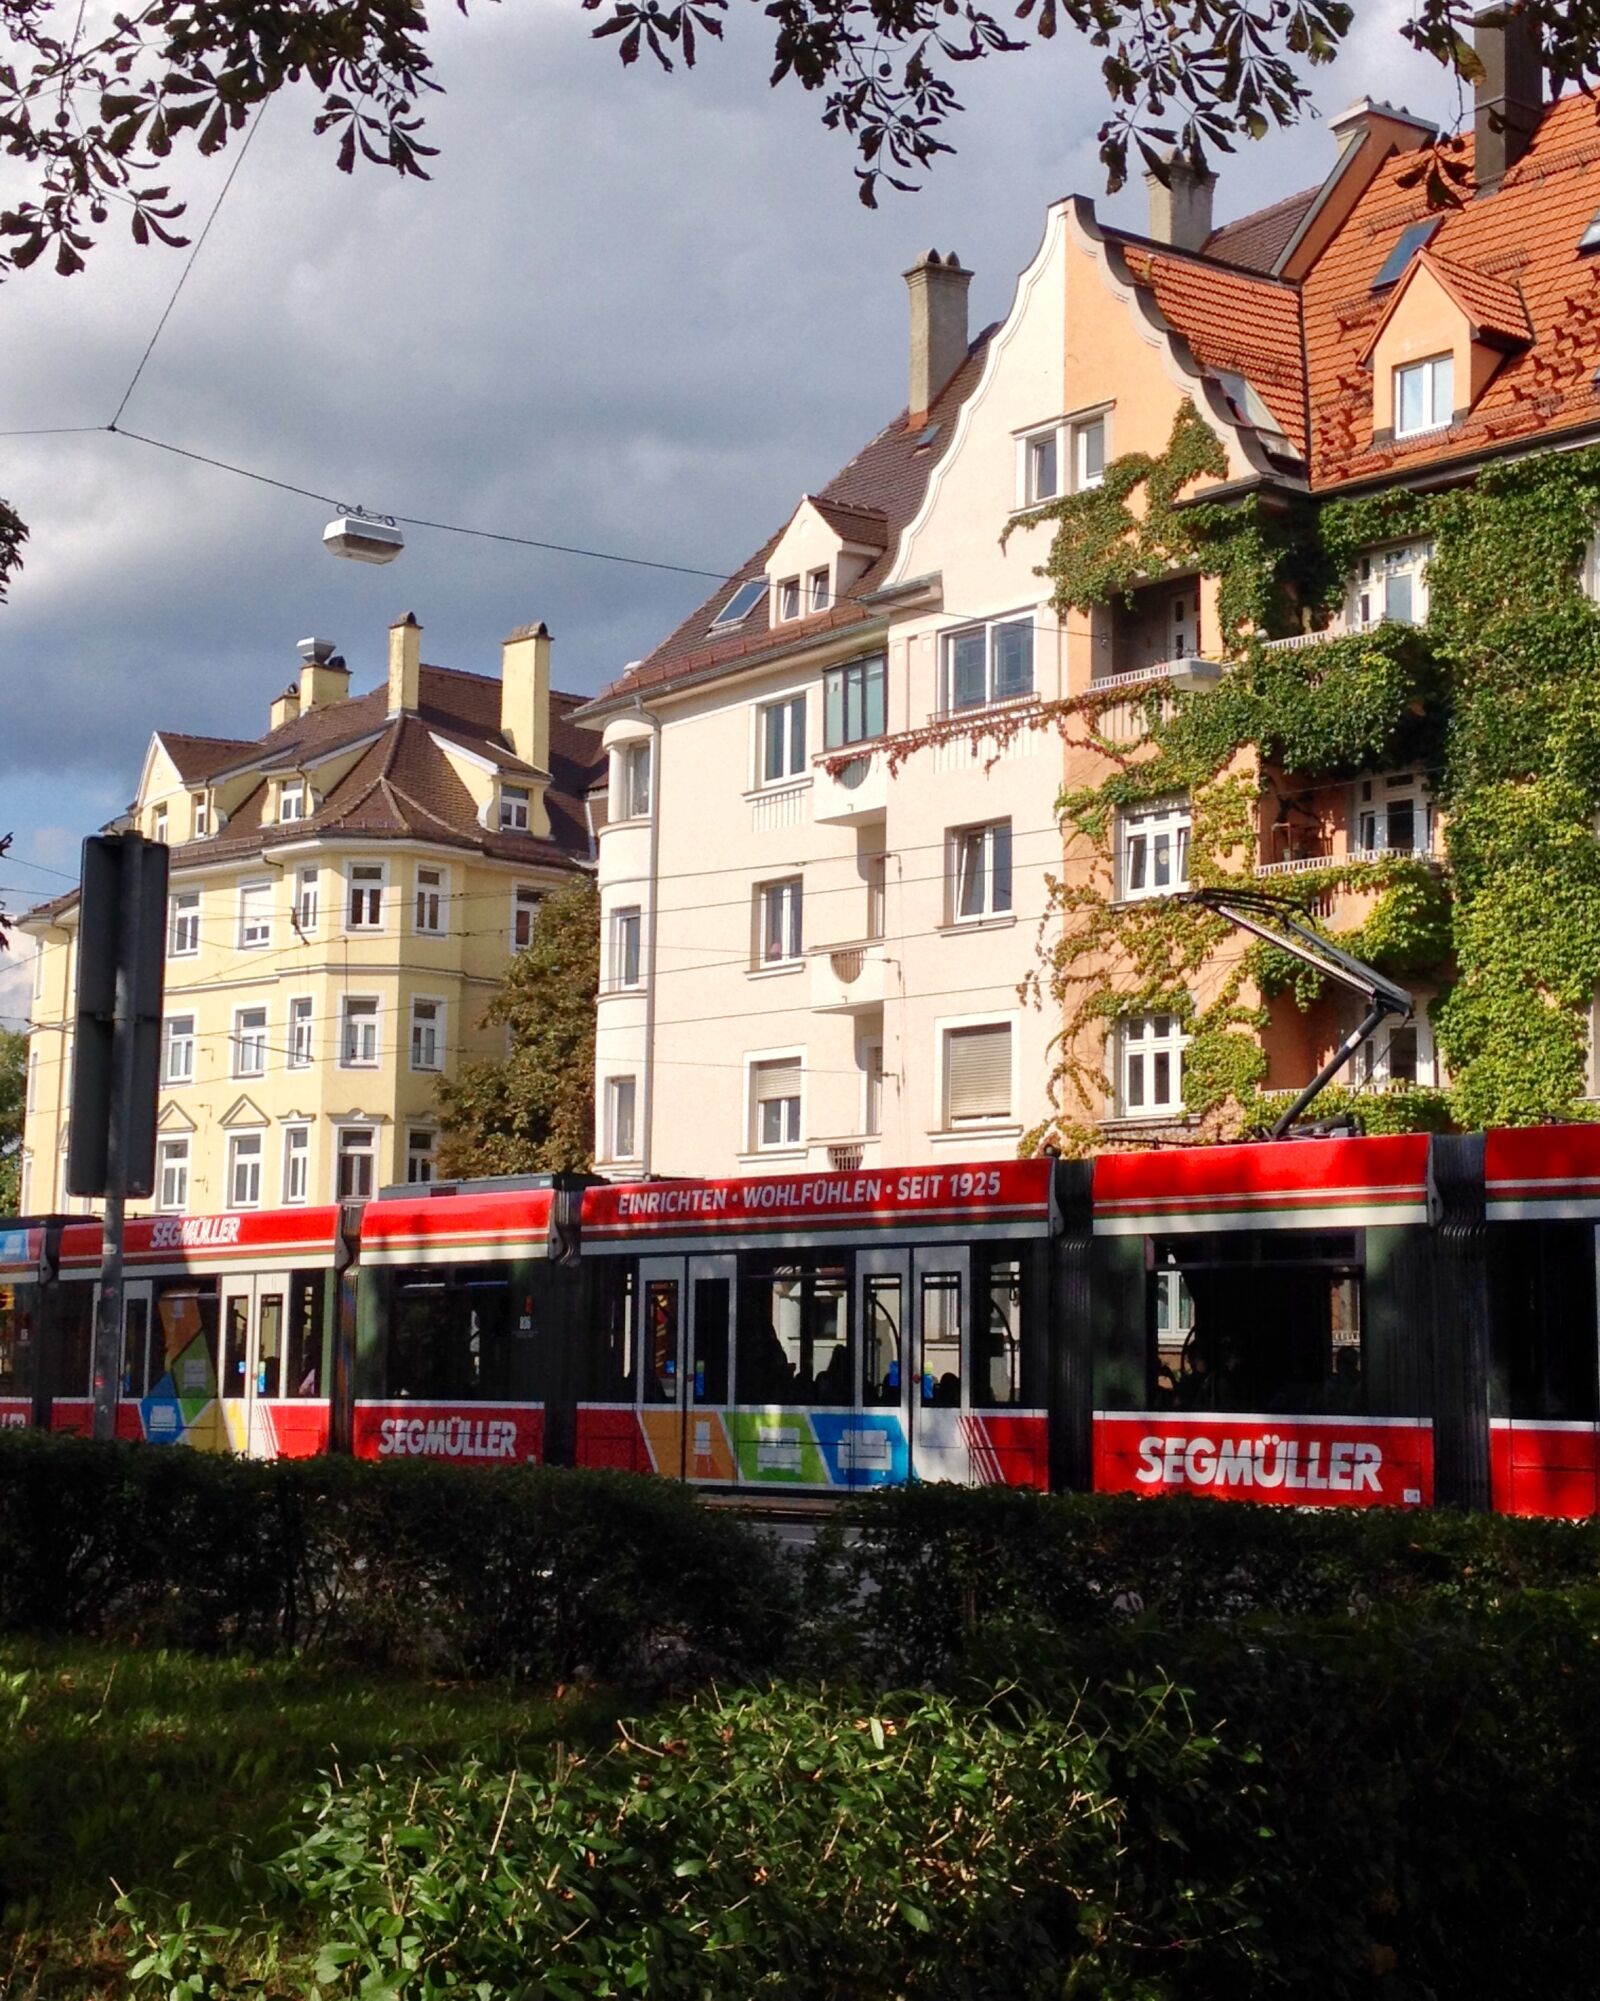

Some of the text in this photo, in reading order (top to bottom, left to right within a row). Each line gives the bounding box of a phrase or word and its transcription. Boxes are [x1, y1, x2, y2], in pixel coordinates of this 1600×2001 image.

[618, 1171, 1001, 1215] EINRICHTEN WOHLFÜHLEN SEIT 1925
[149, 1216, 240, 1248] SEGMÜLLER
[378, 1416, 517, 1457] SEGMÜLLER
[1136, 1434, 1383, 1491] SEGMÜLLER
